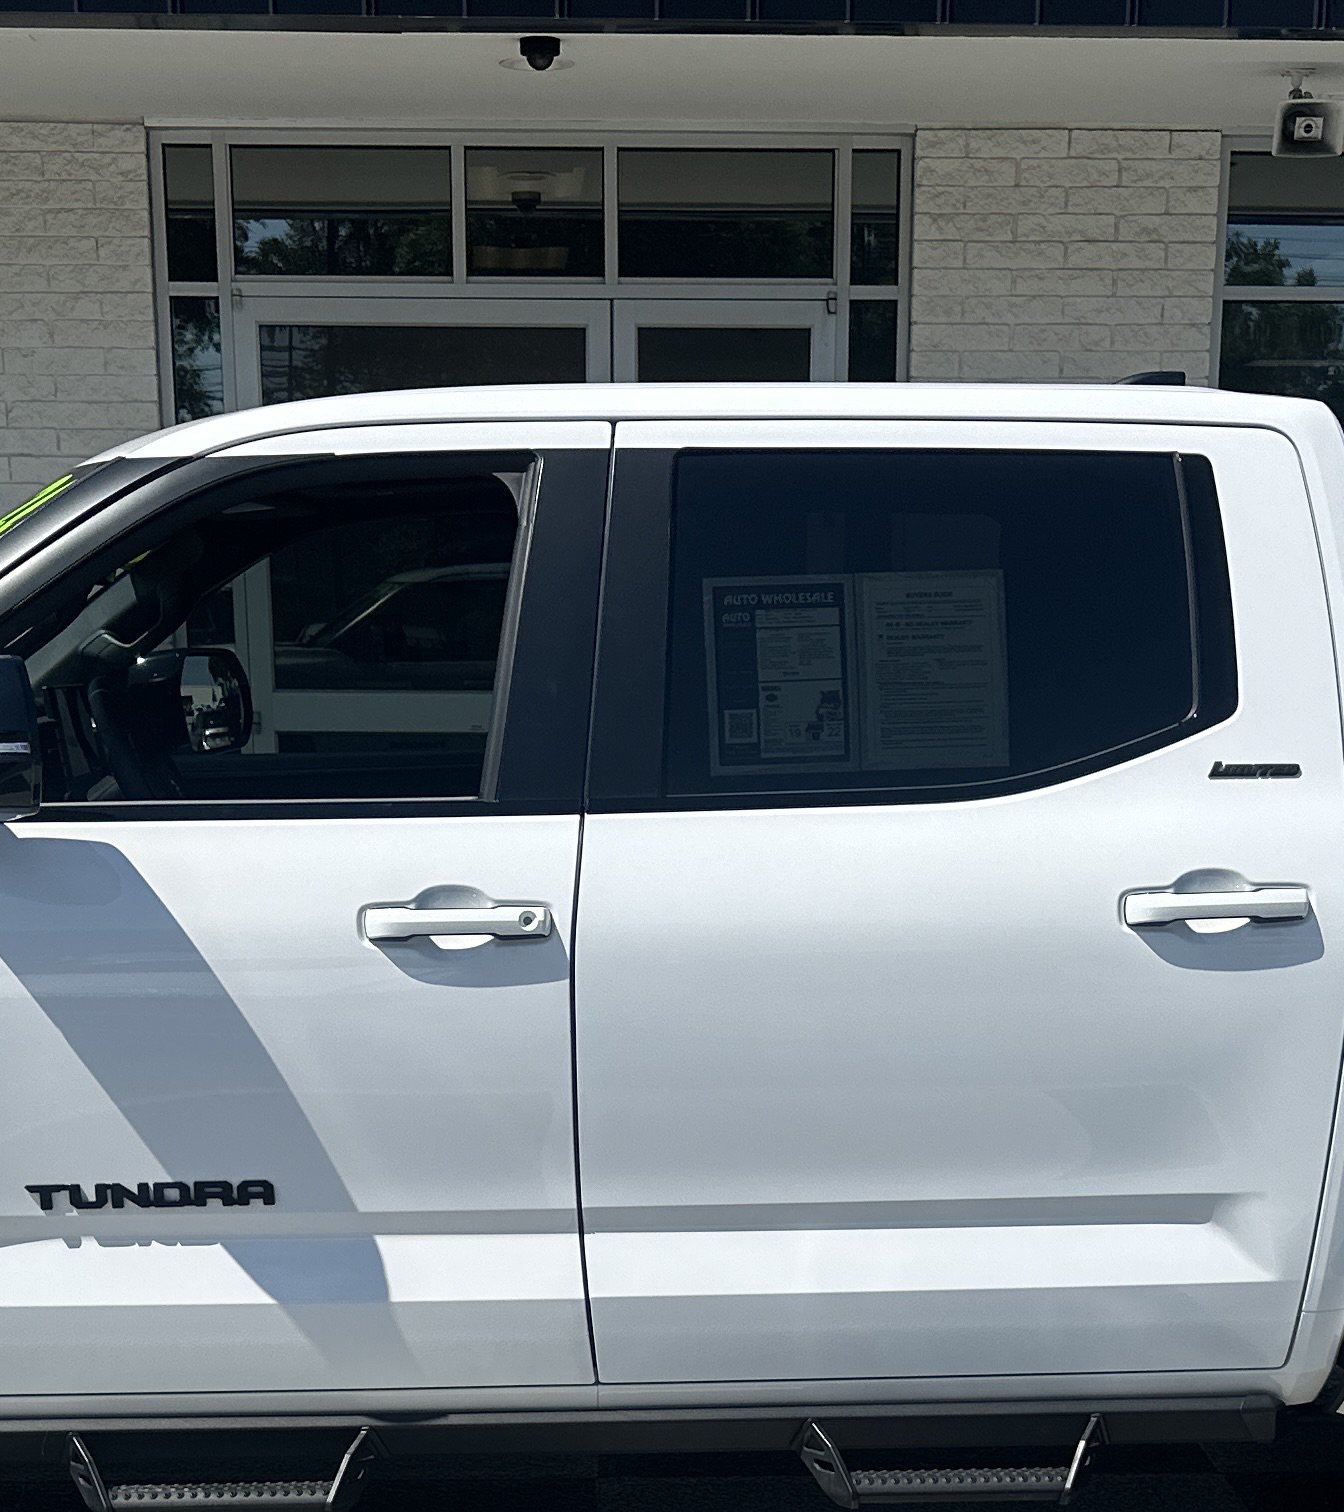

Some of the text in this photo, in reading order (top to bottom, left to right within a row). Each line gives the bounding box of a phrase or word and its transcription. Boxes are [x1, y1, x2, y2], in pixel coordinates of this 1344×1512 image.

[724, 591, 835, 606] AUTO WHOLESALE
[24, 1179, 276, 1211] TUNDRA
